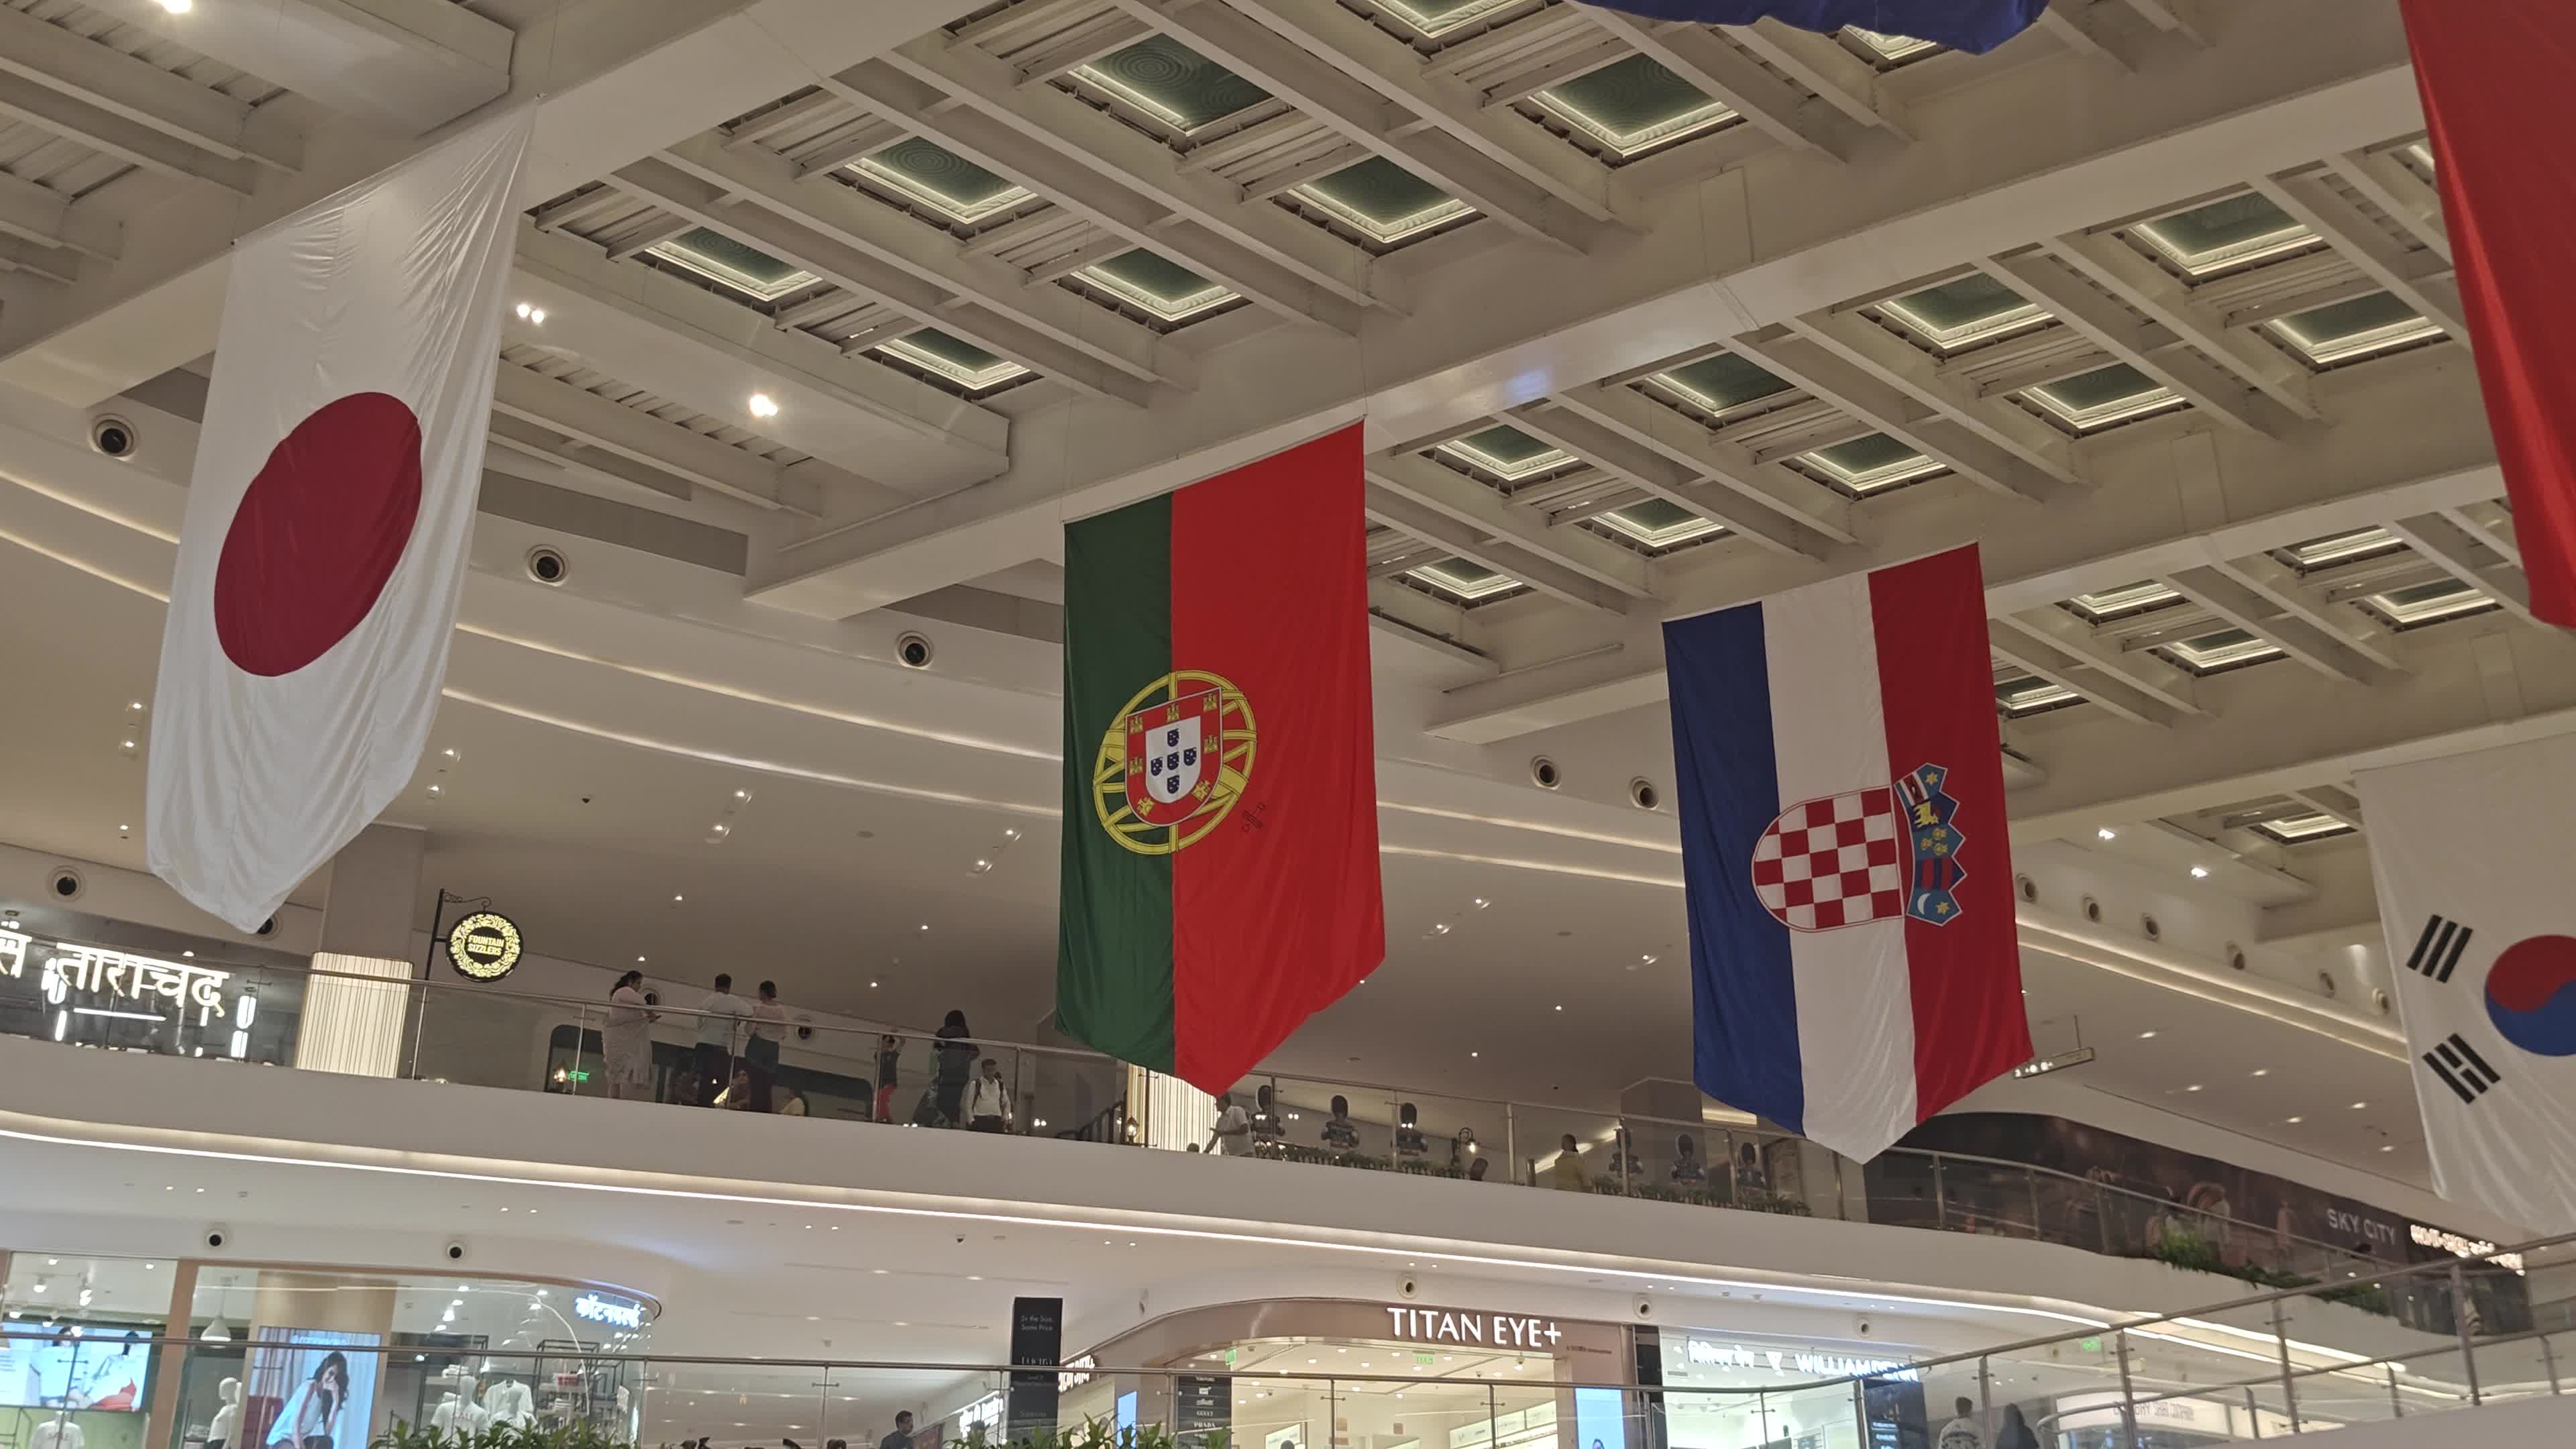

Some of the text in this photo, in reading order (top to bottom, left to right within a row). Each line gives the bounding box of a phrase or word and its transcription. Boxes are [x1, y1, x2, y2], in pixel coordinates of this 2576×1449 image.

[468, 934, 504, 947] FOUNTAIN
[468, 943, 502, 956] SIZZLERS
[2326, 1208, 2361, 1233] SKY
[2363, 1218, 2396, 1244] CITY
[1386, 1307, 1562, 1347] TITAN EYE+
